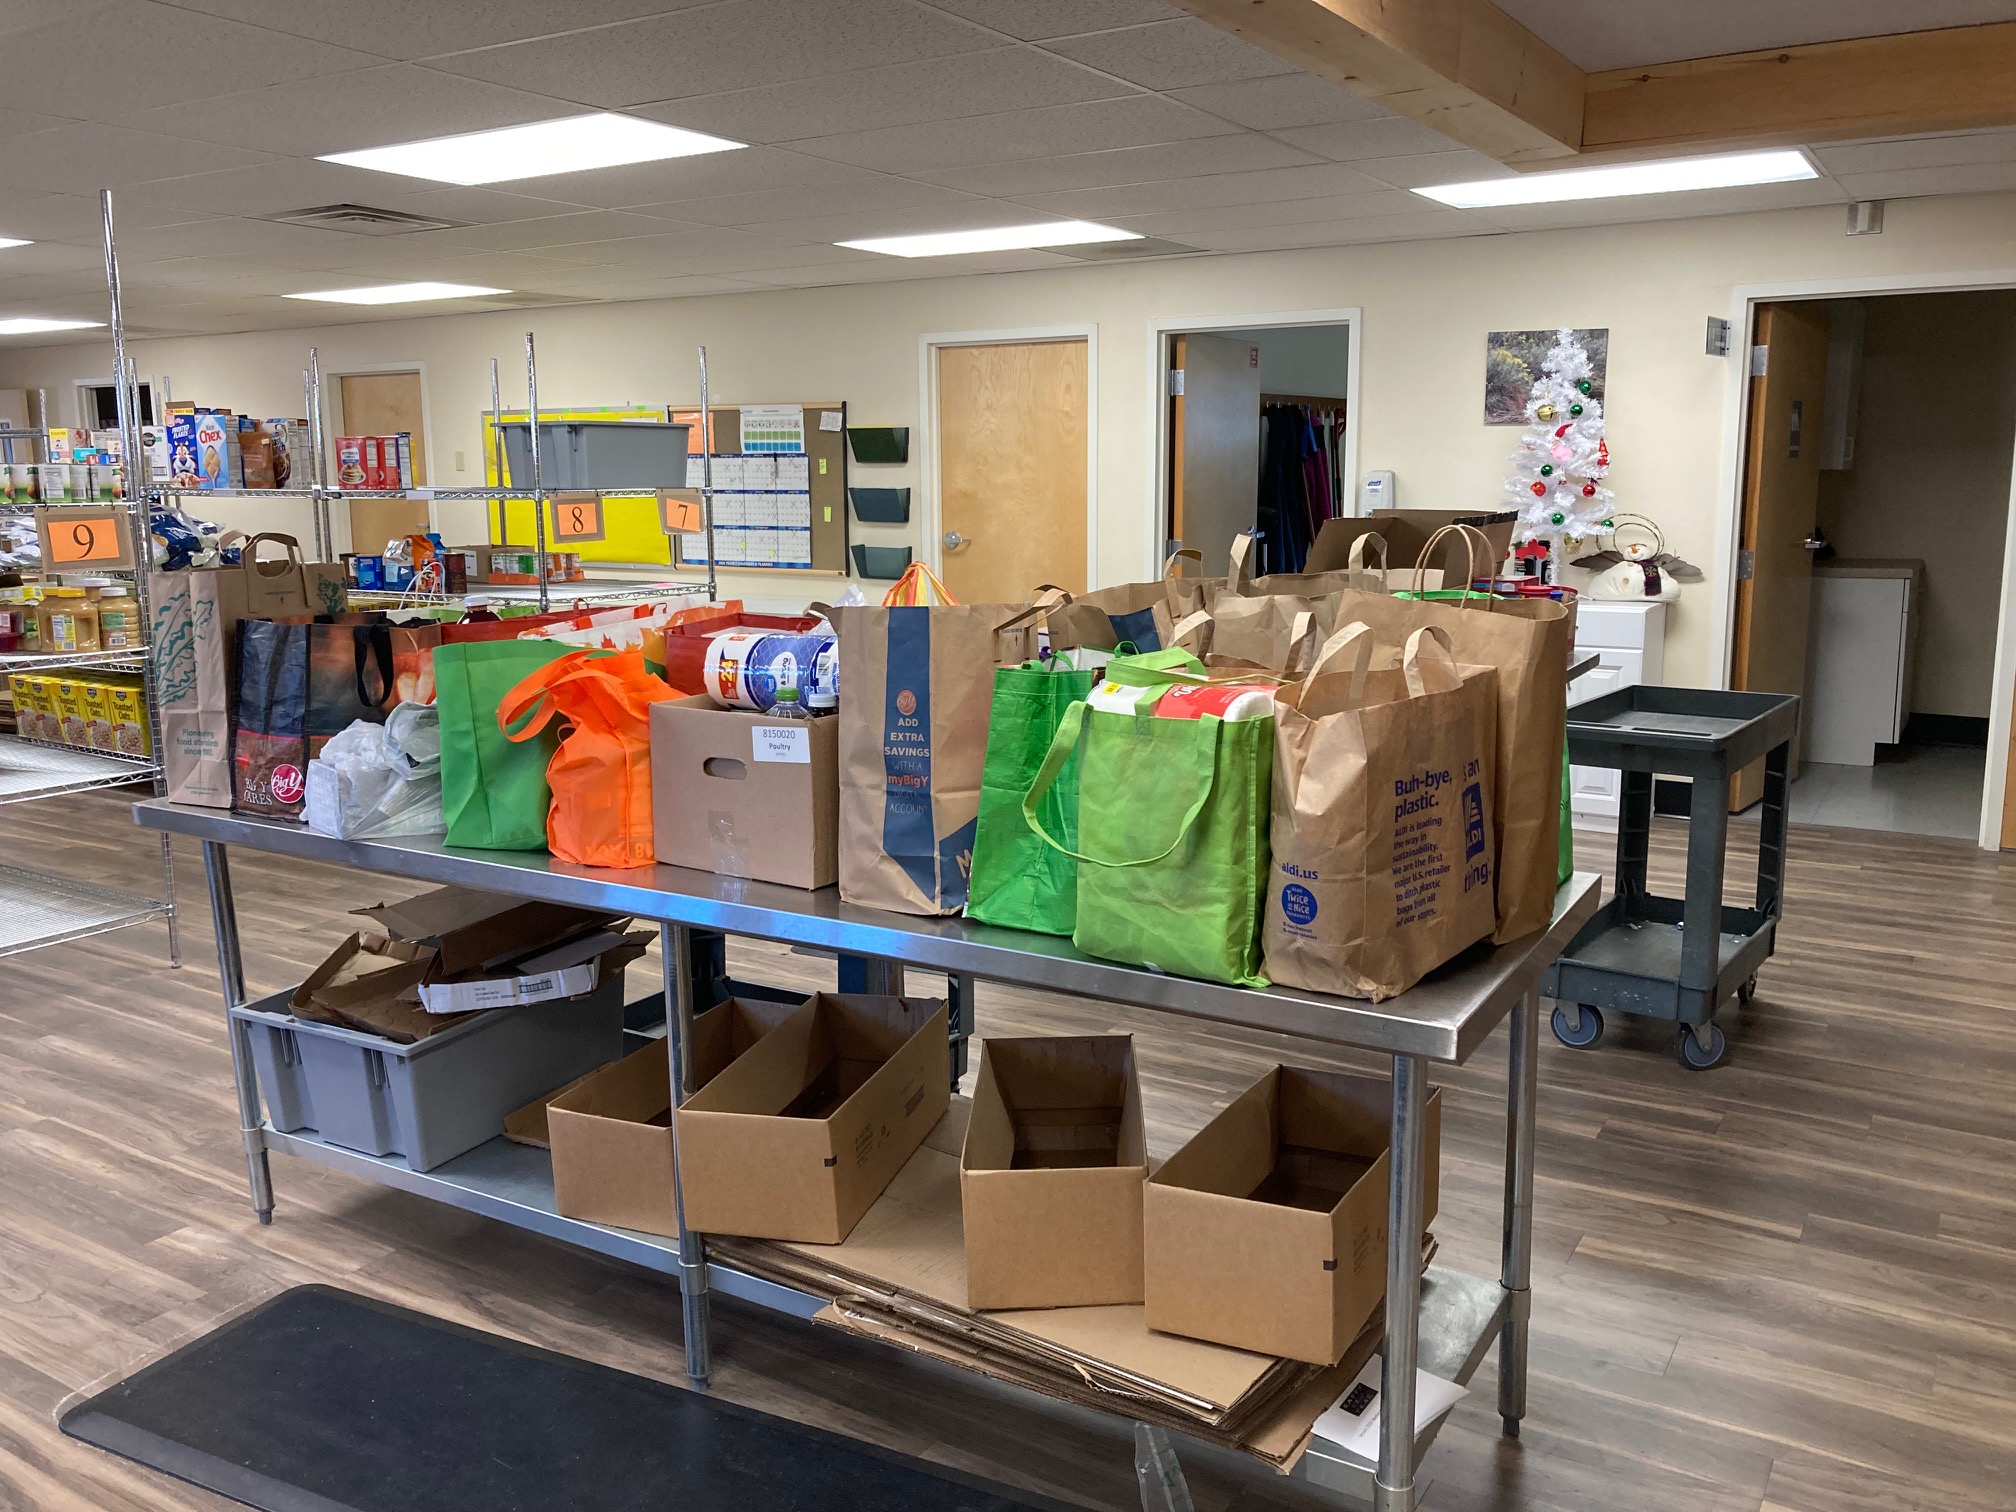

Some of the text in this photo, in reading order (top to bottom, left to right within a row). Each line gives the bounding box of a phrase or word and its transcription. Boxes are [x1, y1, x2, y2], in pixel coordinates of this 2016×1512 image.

[199, 429, 222, 444] Chex
[571, 506, 584, 533] 8
[677, 504, 689, 528] 7
[72, 524, 95, 559] 9
[721, 660, 735, 682] 24
[112, 701, 134, 712] Toasted
[897, 718, 919, 727] ADD
[176, 737, 192, 745] food
[762, 729, 796, 739] 8150020
[890, 732, 925, 742] EXTRA
[769, 743, 791, 751] Poultry
[884, 746, 930, 757] SAVINGS
[891, 761, 923, 771] WITH A
[260, 781, 268, 793] Y
[1394, 770, 1453, 797] Buh-bye,
[1394, 791, 1440, 823] plastic.
[1409, 823, 1415, 832] is
[1416, 817, 1443, 830] leading
[1393, 833, 1427, 850] the way in
[1281, 862, 1319, 880] aldi.us
[1403, 863, 1414, 872] are
[1414, 858, 1427, 868] the
[1427, 853, 1443, 864] first
[1394, 876, 1411, 889] major
[1424, 864, 1452, 877] retailer
[1396, 893, 1403, 903] to
[1419, 879, 1441, 895] plastic
[1396, 903, 1413, 915] bags
[1426, 893, 1436, 903] all
